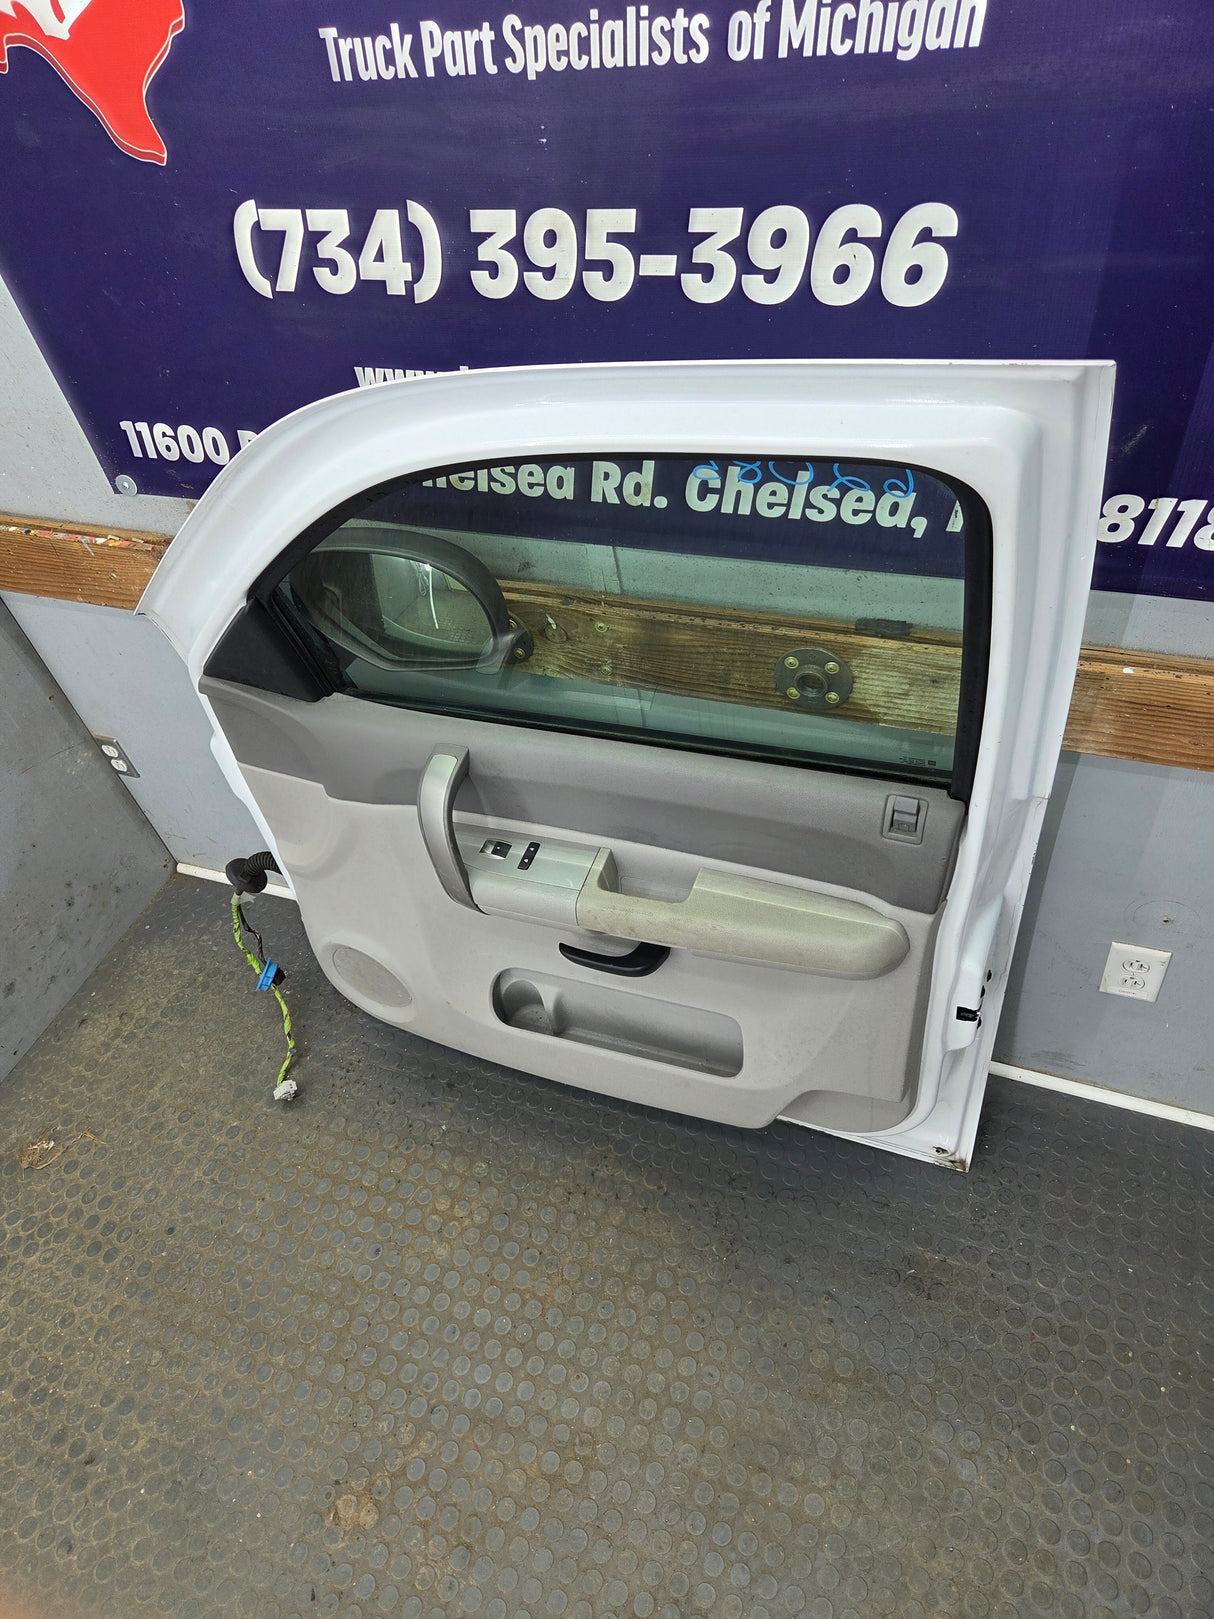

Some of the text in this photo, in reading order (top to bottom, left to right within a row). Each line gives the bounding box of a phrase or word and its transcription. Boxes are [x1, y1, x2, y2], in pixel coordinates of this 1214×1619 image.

[319, 0, 988, 82] Truck Part Specialists of Michigan
[232, 199, 960, 308] (734) 395-3966
[119, 420, 230, 466] 11600
[590, 460, 669, 509] Rd.
[684, 465, 929, 539] Chelsea,
